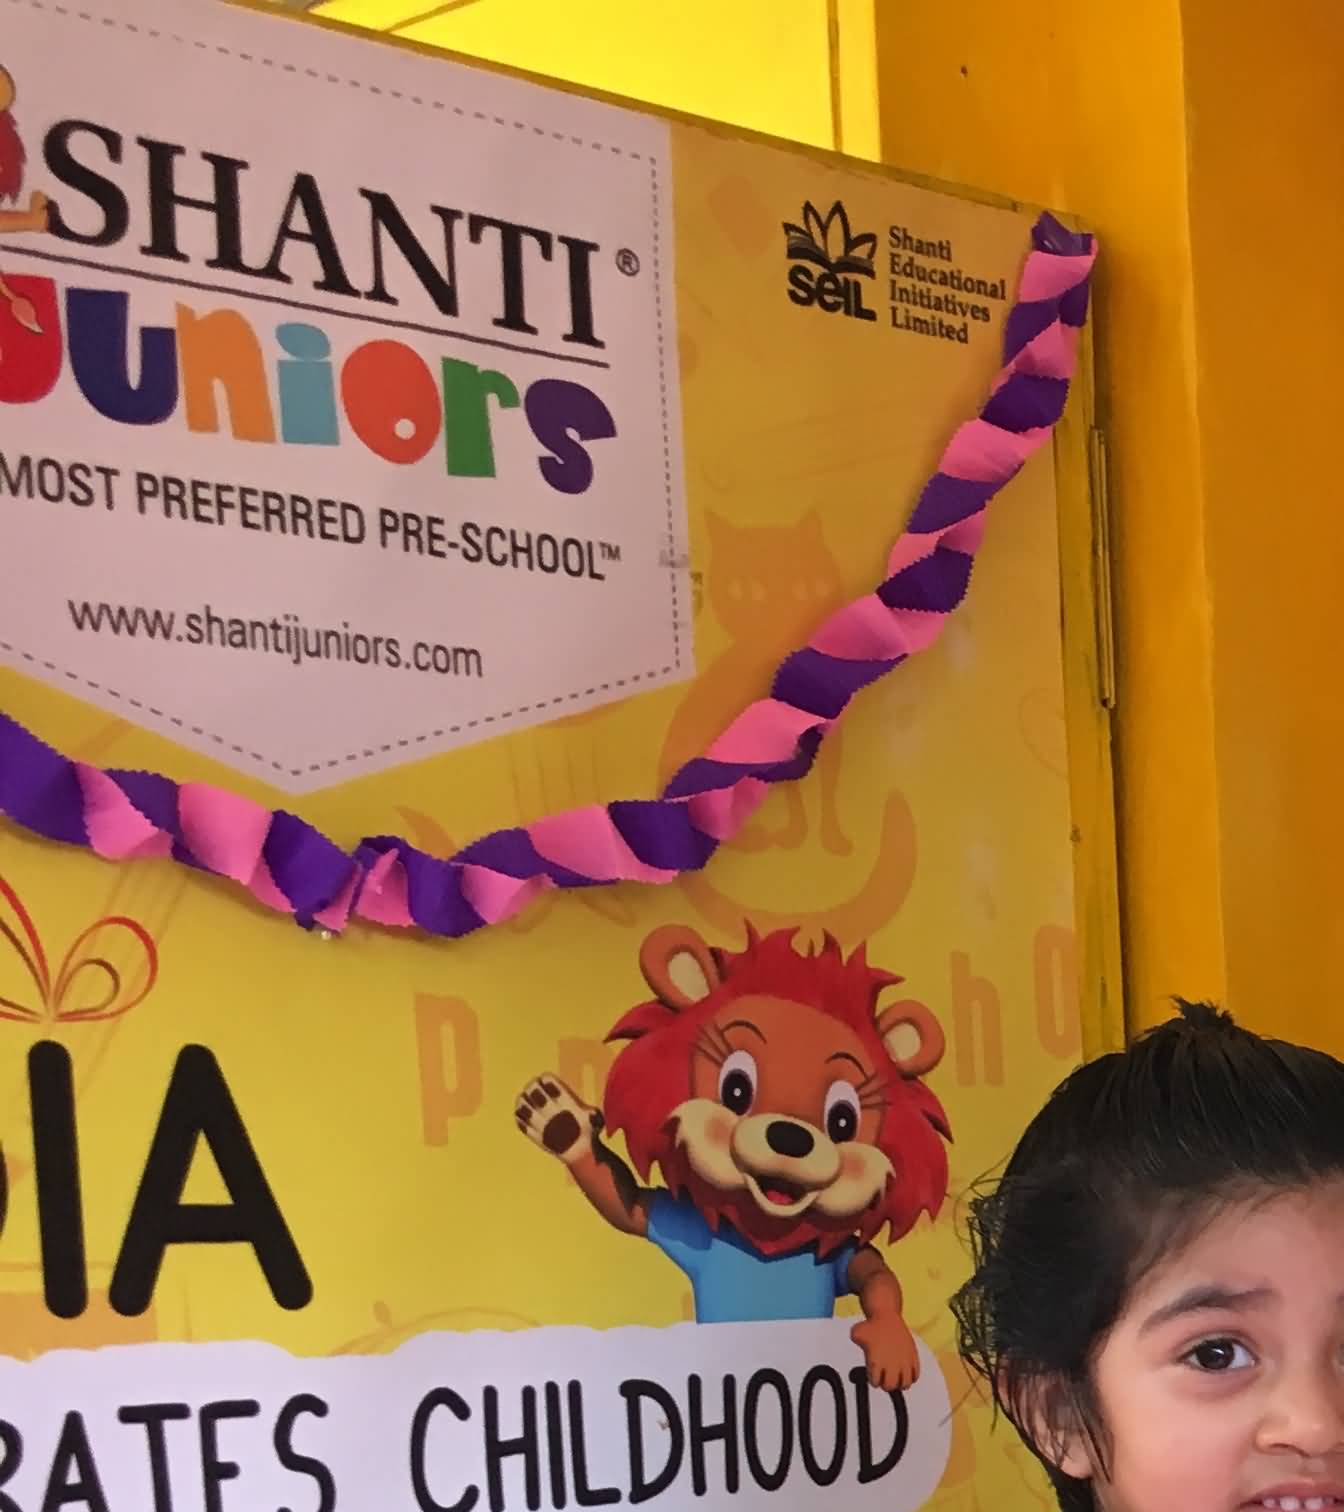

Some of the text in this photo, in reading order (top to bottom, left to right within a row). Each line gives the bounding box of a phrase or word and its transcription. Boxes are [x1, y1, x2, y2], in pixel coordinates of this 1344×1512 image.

[888, 226, 953, 262] Shanti
[888, 252, 1007, 301] Educational
[888, 280, 991, 323] Initiatives
[890, 306, 969, 344] Limited
[0, 452, 119, 511] MOST
[136, 471, 366, 545] PREFERRED
[67, 599, 484, 677] www.shantijuniors.com
[0, 1039, 314, 1320] IA
